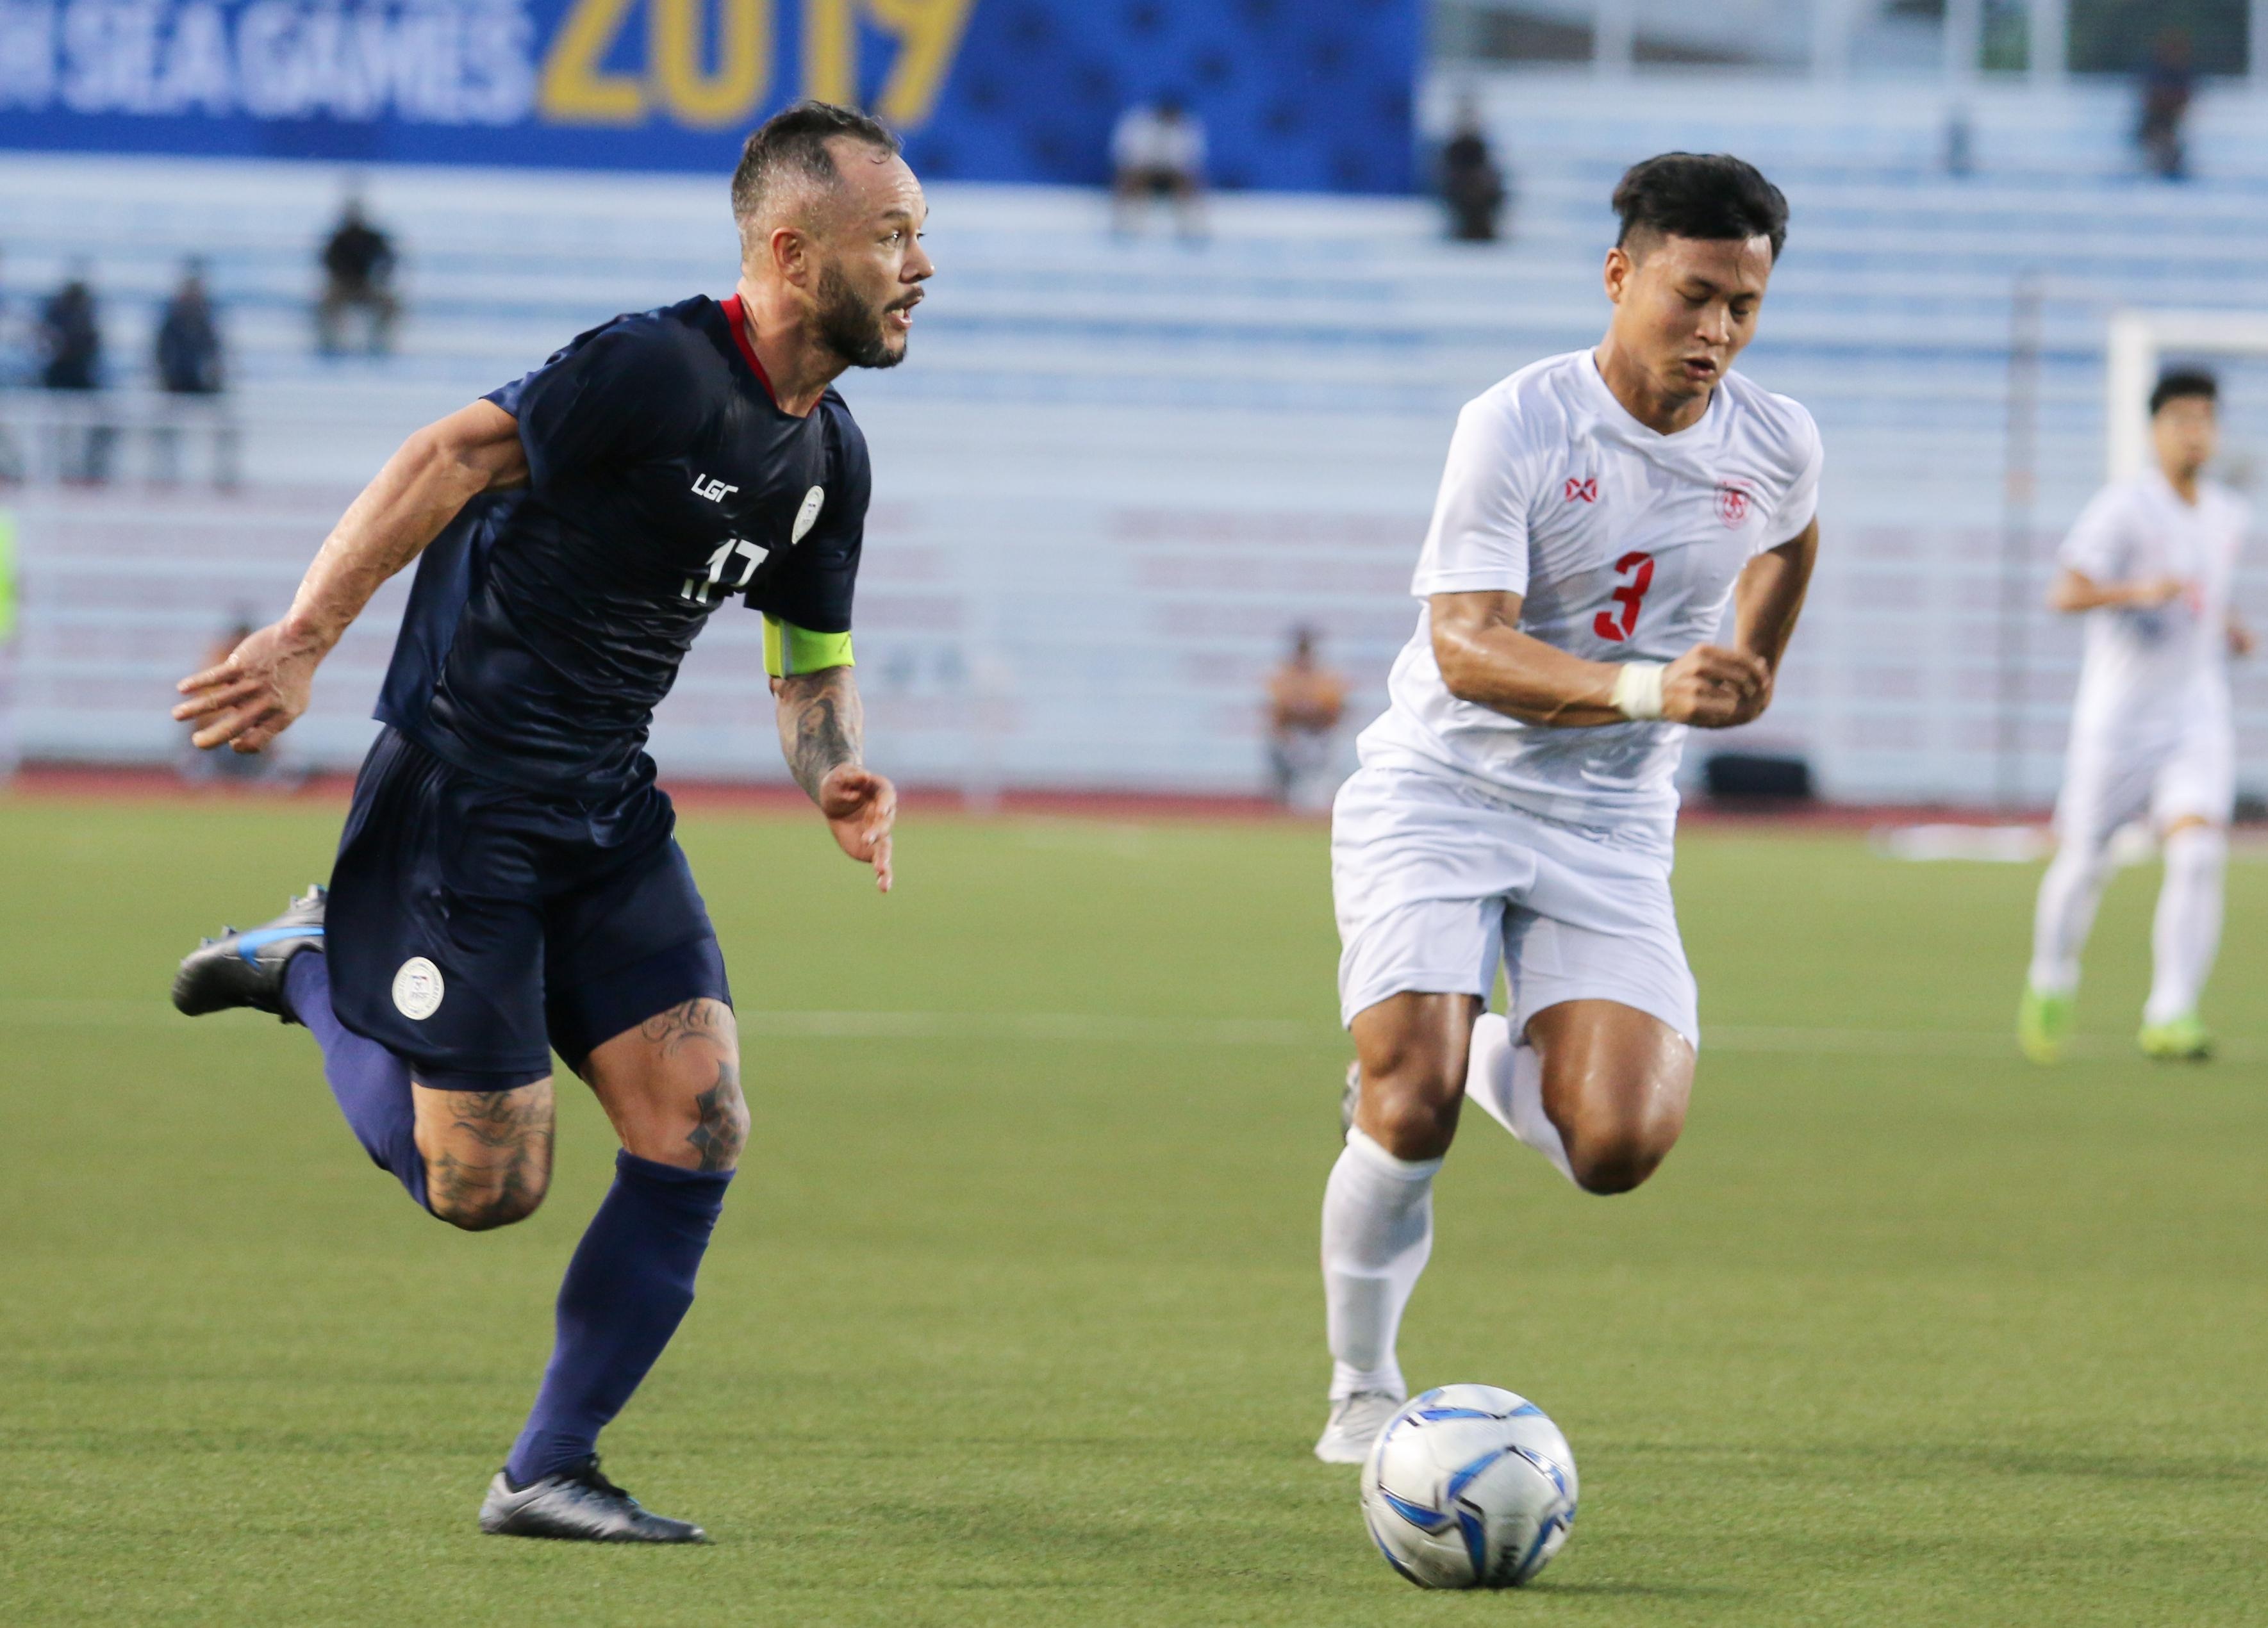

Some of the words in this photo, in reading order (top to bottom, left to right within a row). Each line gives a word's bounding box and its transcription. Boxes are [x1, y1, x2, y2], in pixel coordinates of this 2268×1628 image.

[61, 1, 229, 116] SEA
[237, 1, 533, 122] GAMES
[538, 0, 969, 128] 2019
[681, 538, 770, 604] 17
[1593, 550, 1655, 642] 3
